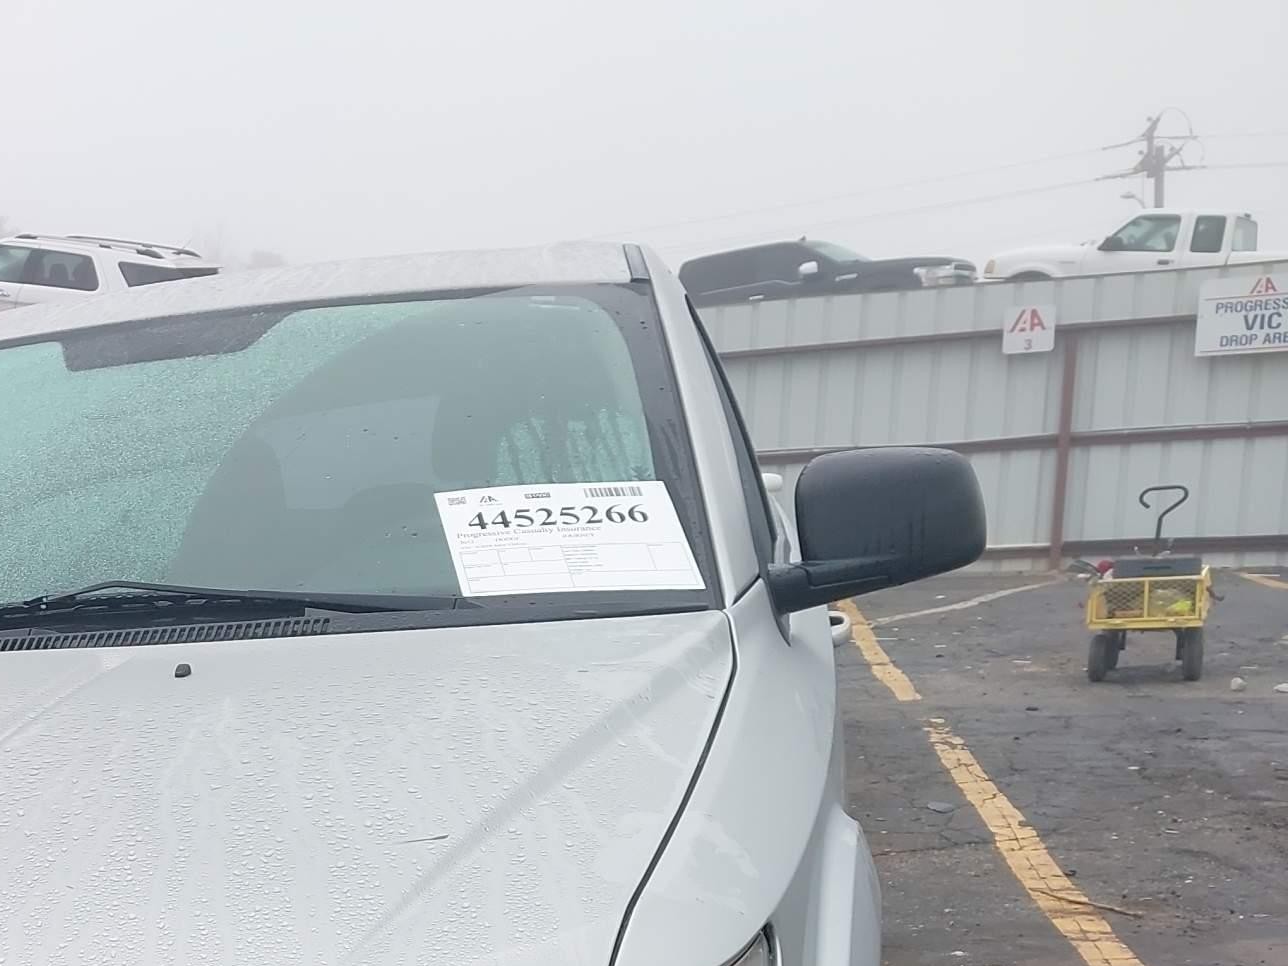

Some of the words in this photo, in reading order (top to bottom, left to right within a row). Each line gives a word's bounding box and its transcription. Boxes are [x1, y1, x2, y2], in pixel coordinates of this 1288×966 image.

[1243, 311, 1283, 331] VIC
[1023, 338, 1033, 351] 3
[1219, 333, 1258, 347] DROP
[467, 503, 650, 530] 44525266
[457, 530, 512, 539] Progressive
